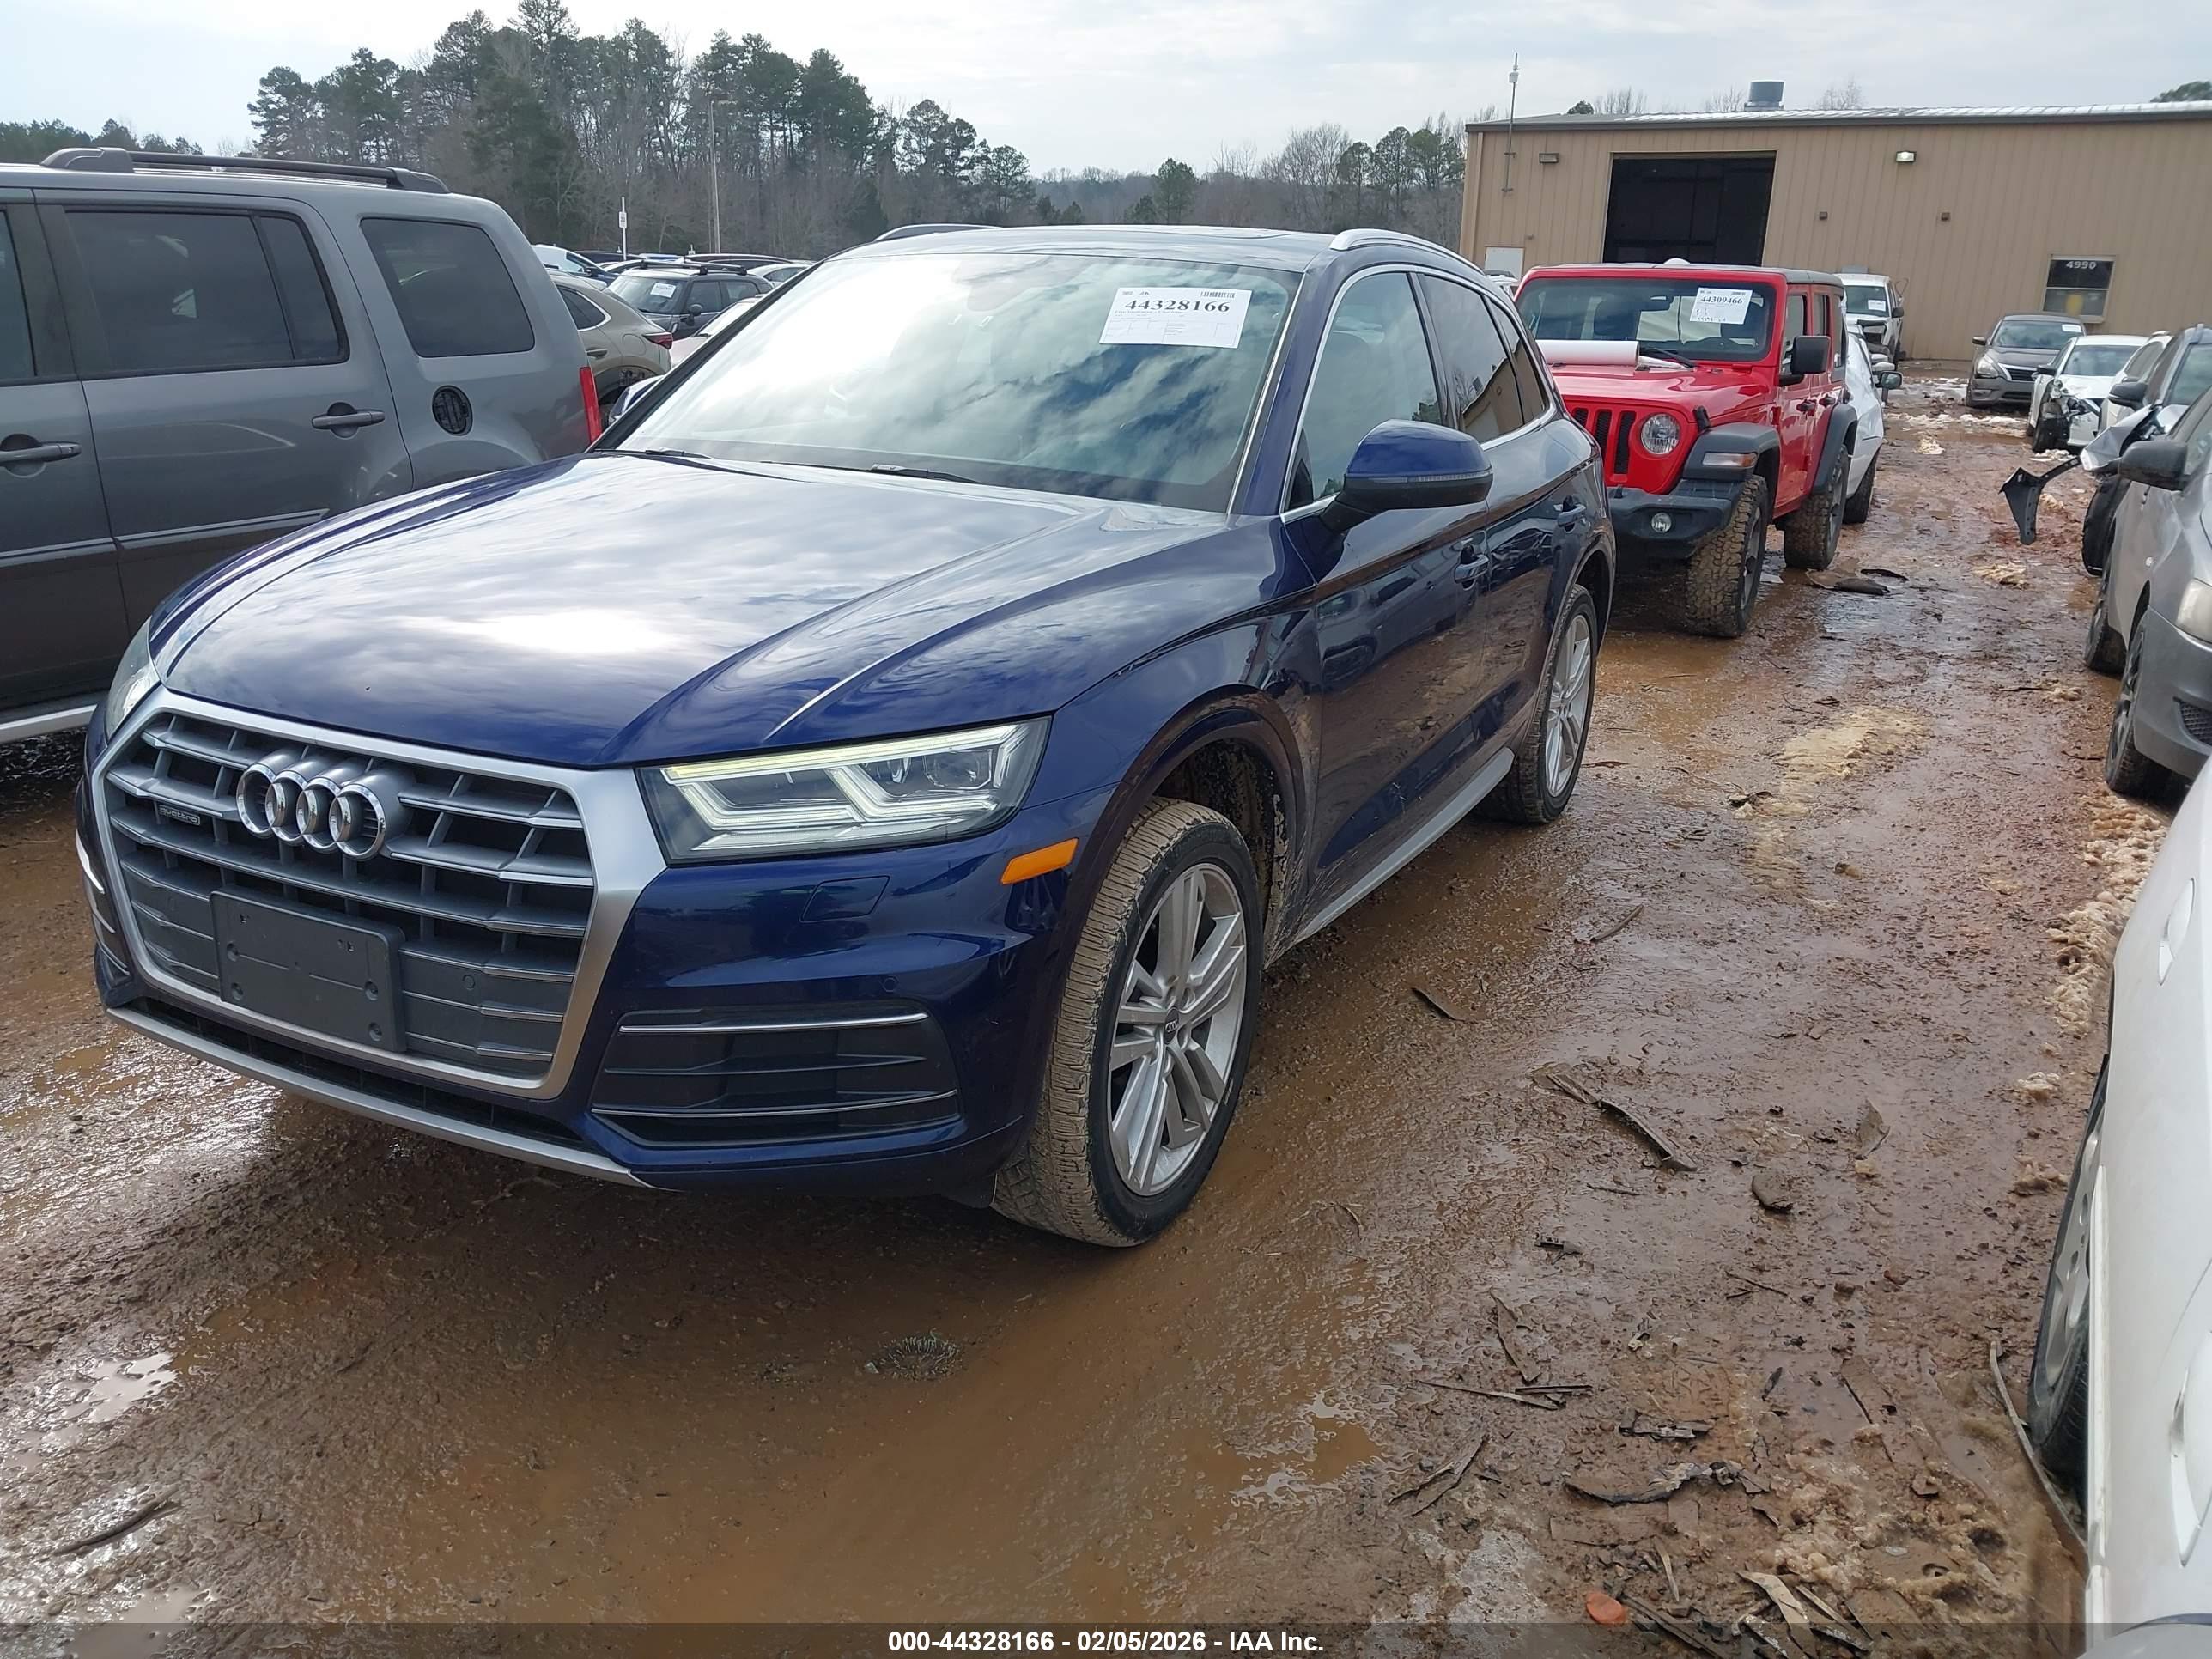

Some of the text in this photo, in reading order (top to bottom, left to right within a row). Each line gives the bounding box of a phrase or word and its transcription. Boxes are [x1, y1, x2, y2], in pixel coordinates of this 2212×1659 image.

[2066, 260, 2097, 270] 4990
[1124, 299, 1231, 313] 44328166
[161, 807, 198, 823] quattro
